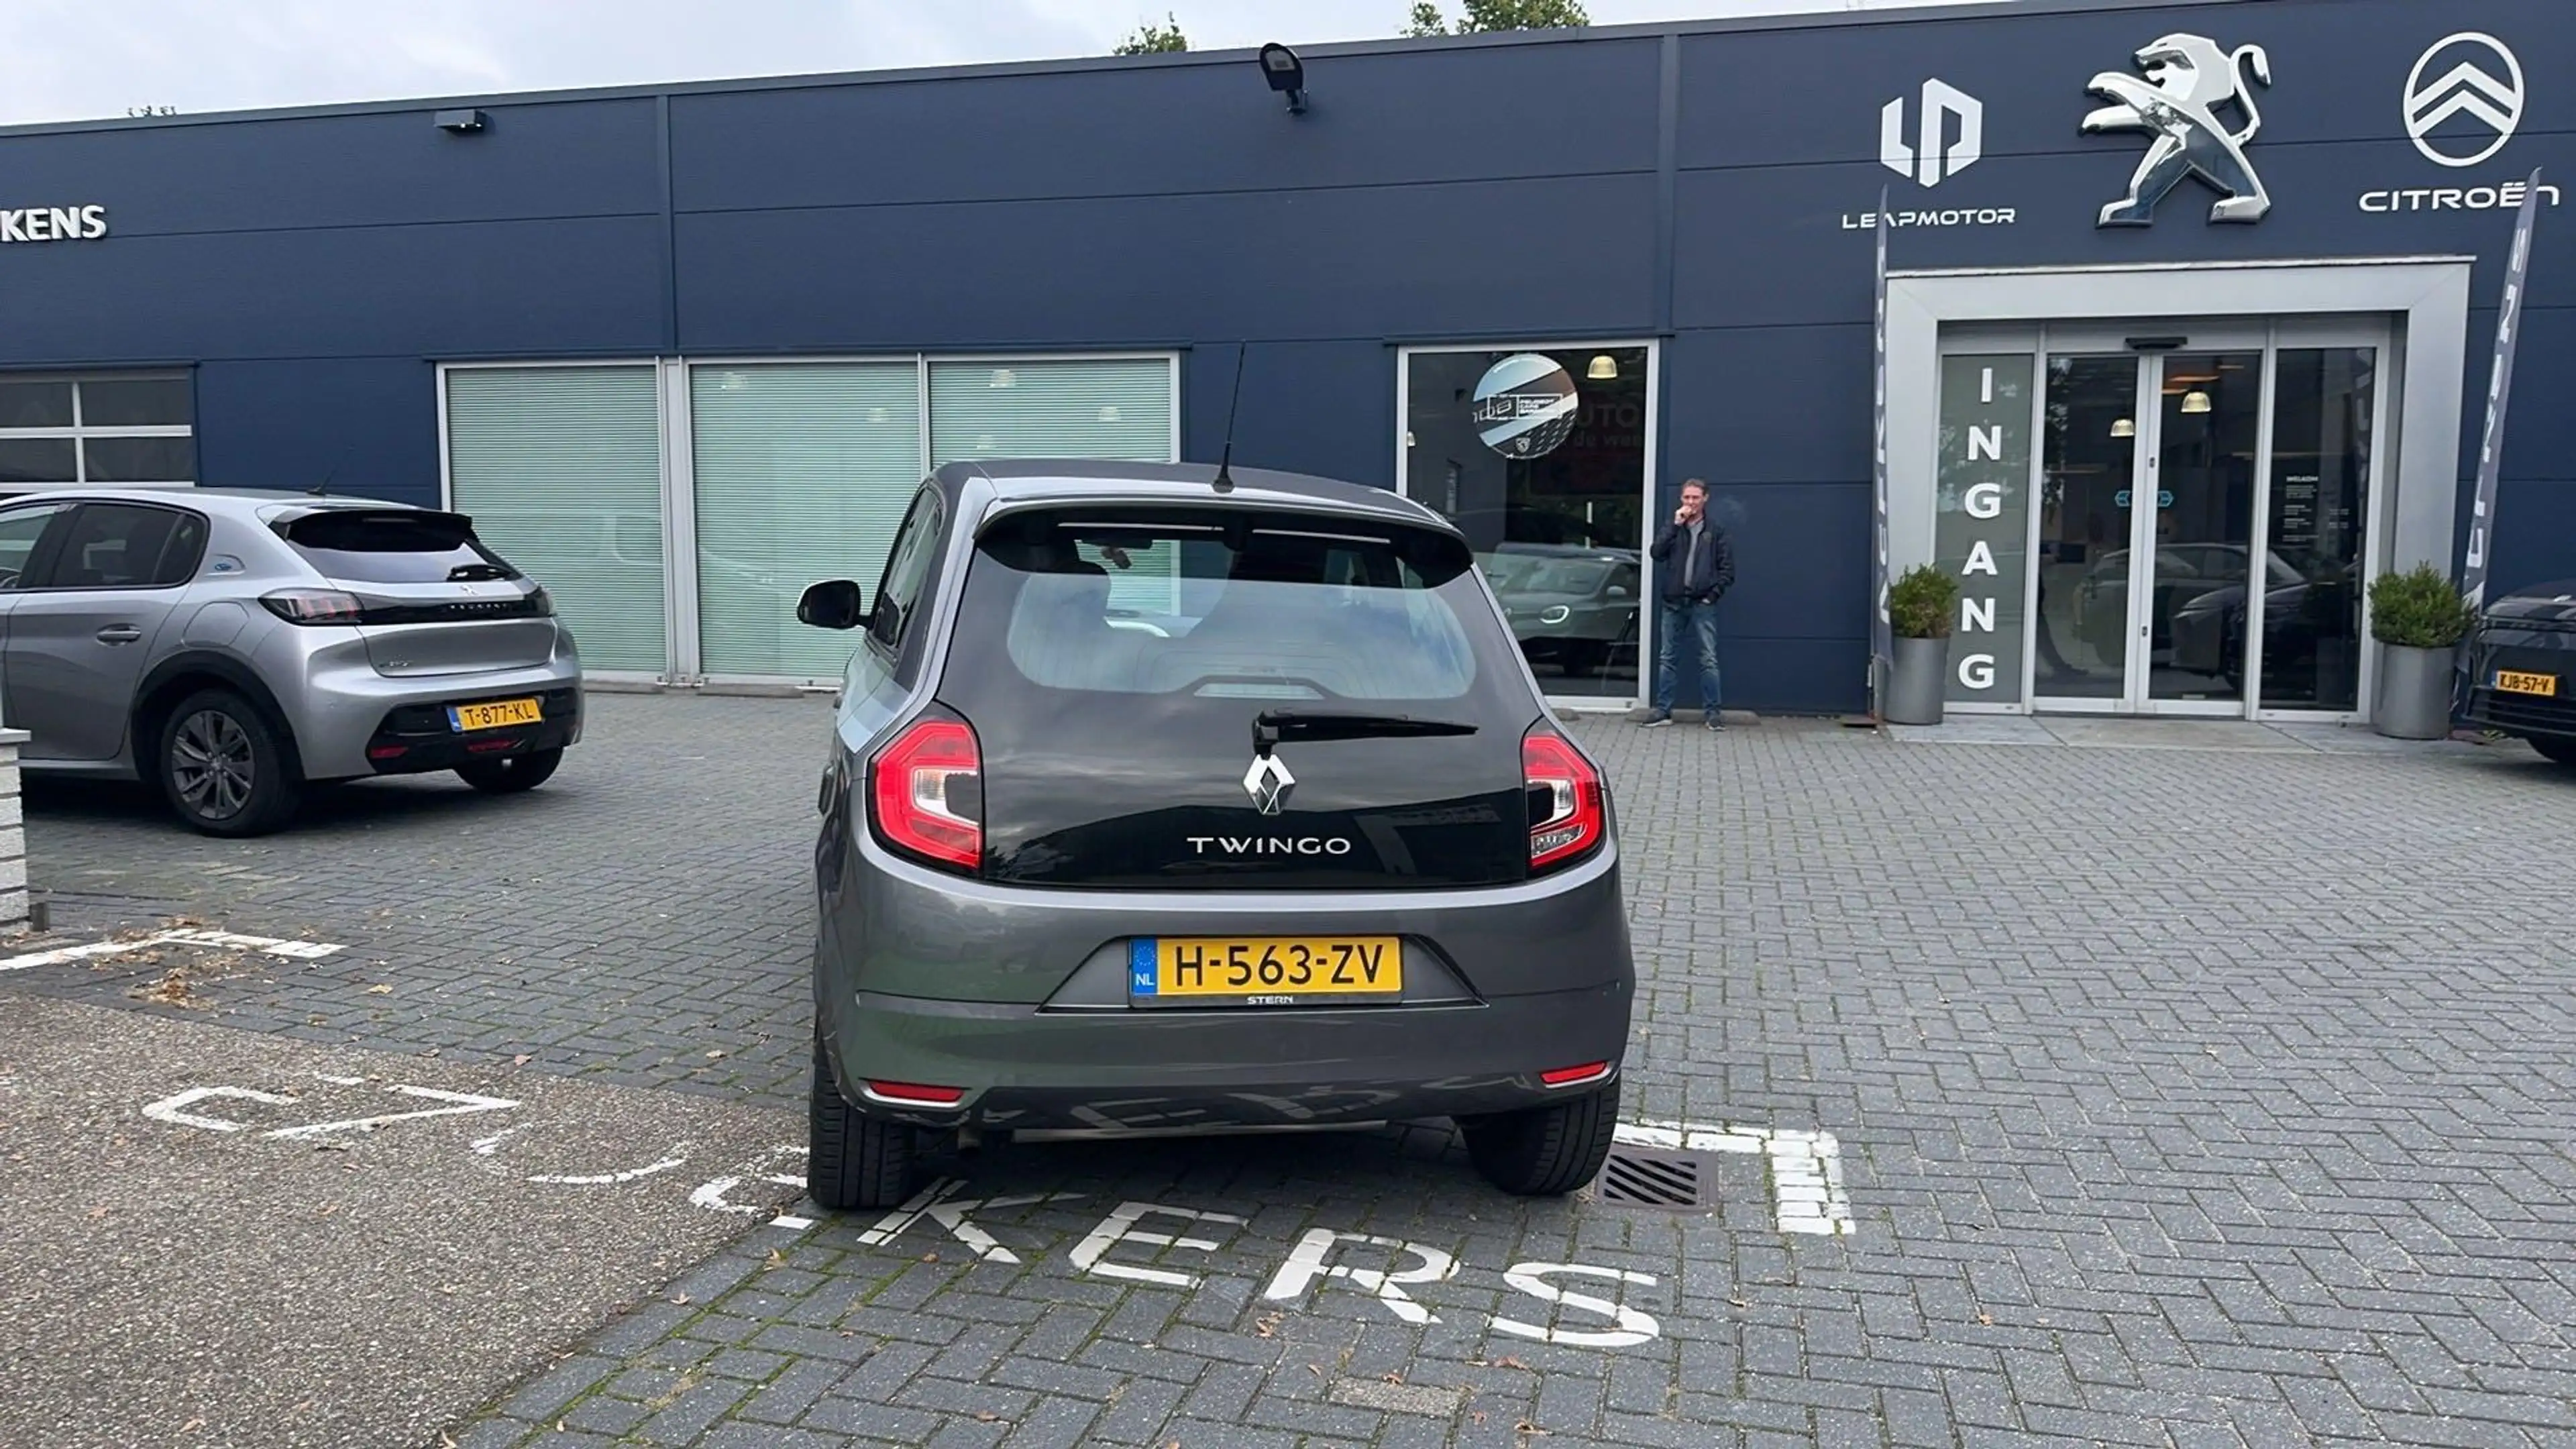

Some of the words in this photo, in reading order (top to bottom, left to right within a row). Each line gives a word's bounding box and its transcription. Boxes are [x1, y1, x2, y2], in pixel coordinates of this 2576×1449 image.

[0, 205, 107, 242] KENS
[1841, 207, 2016, 229] LEAPMOTOR
[1957, 367, 2002, 690] INGANG
[464, 702, 535, 727] T-877-KL
[1186, 837, 1352, 855] TWINGO
[1135, 973, 1155, 987] NL
[1175, 944, 1383, 987] H-563-ZV
[1246, 996, 1294, 1006] STERN
